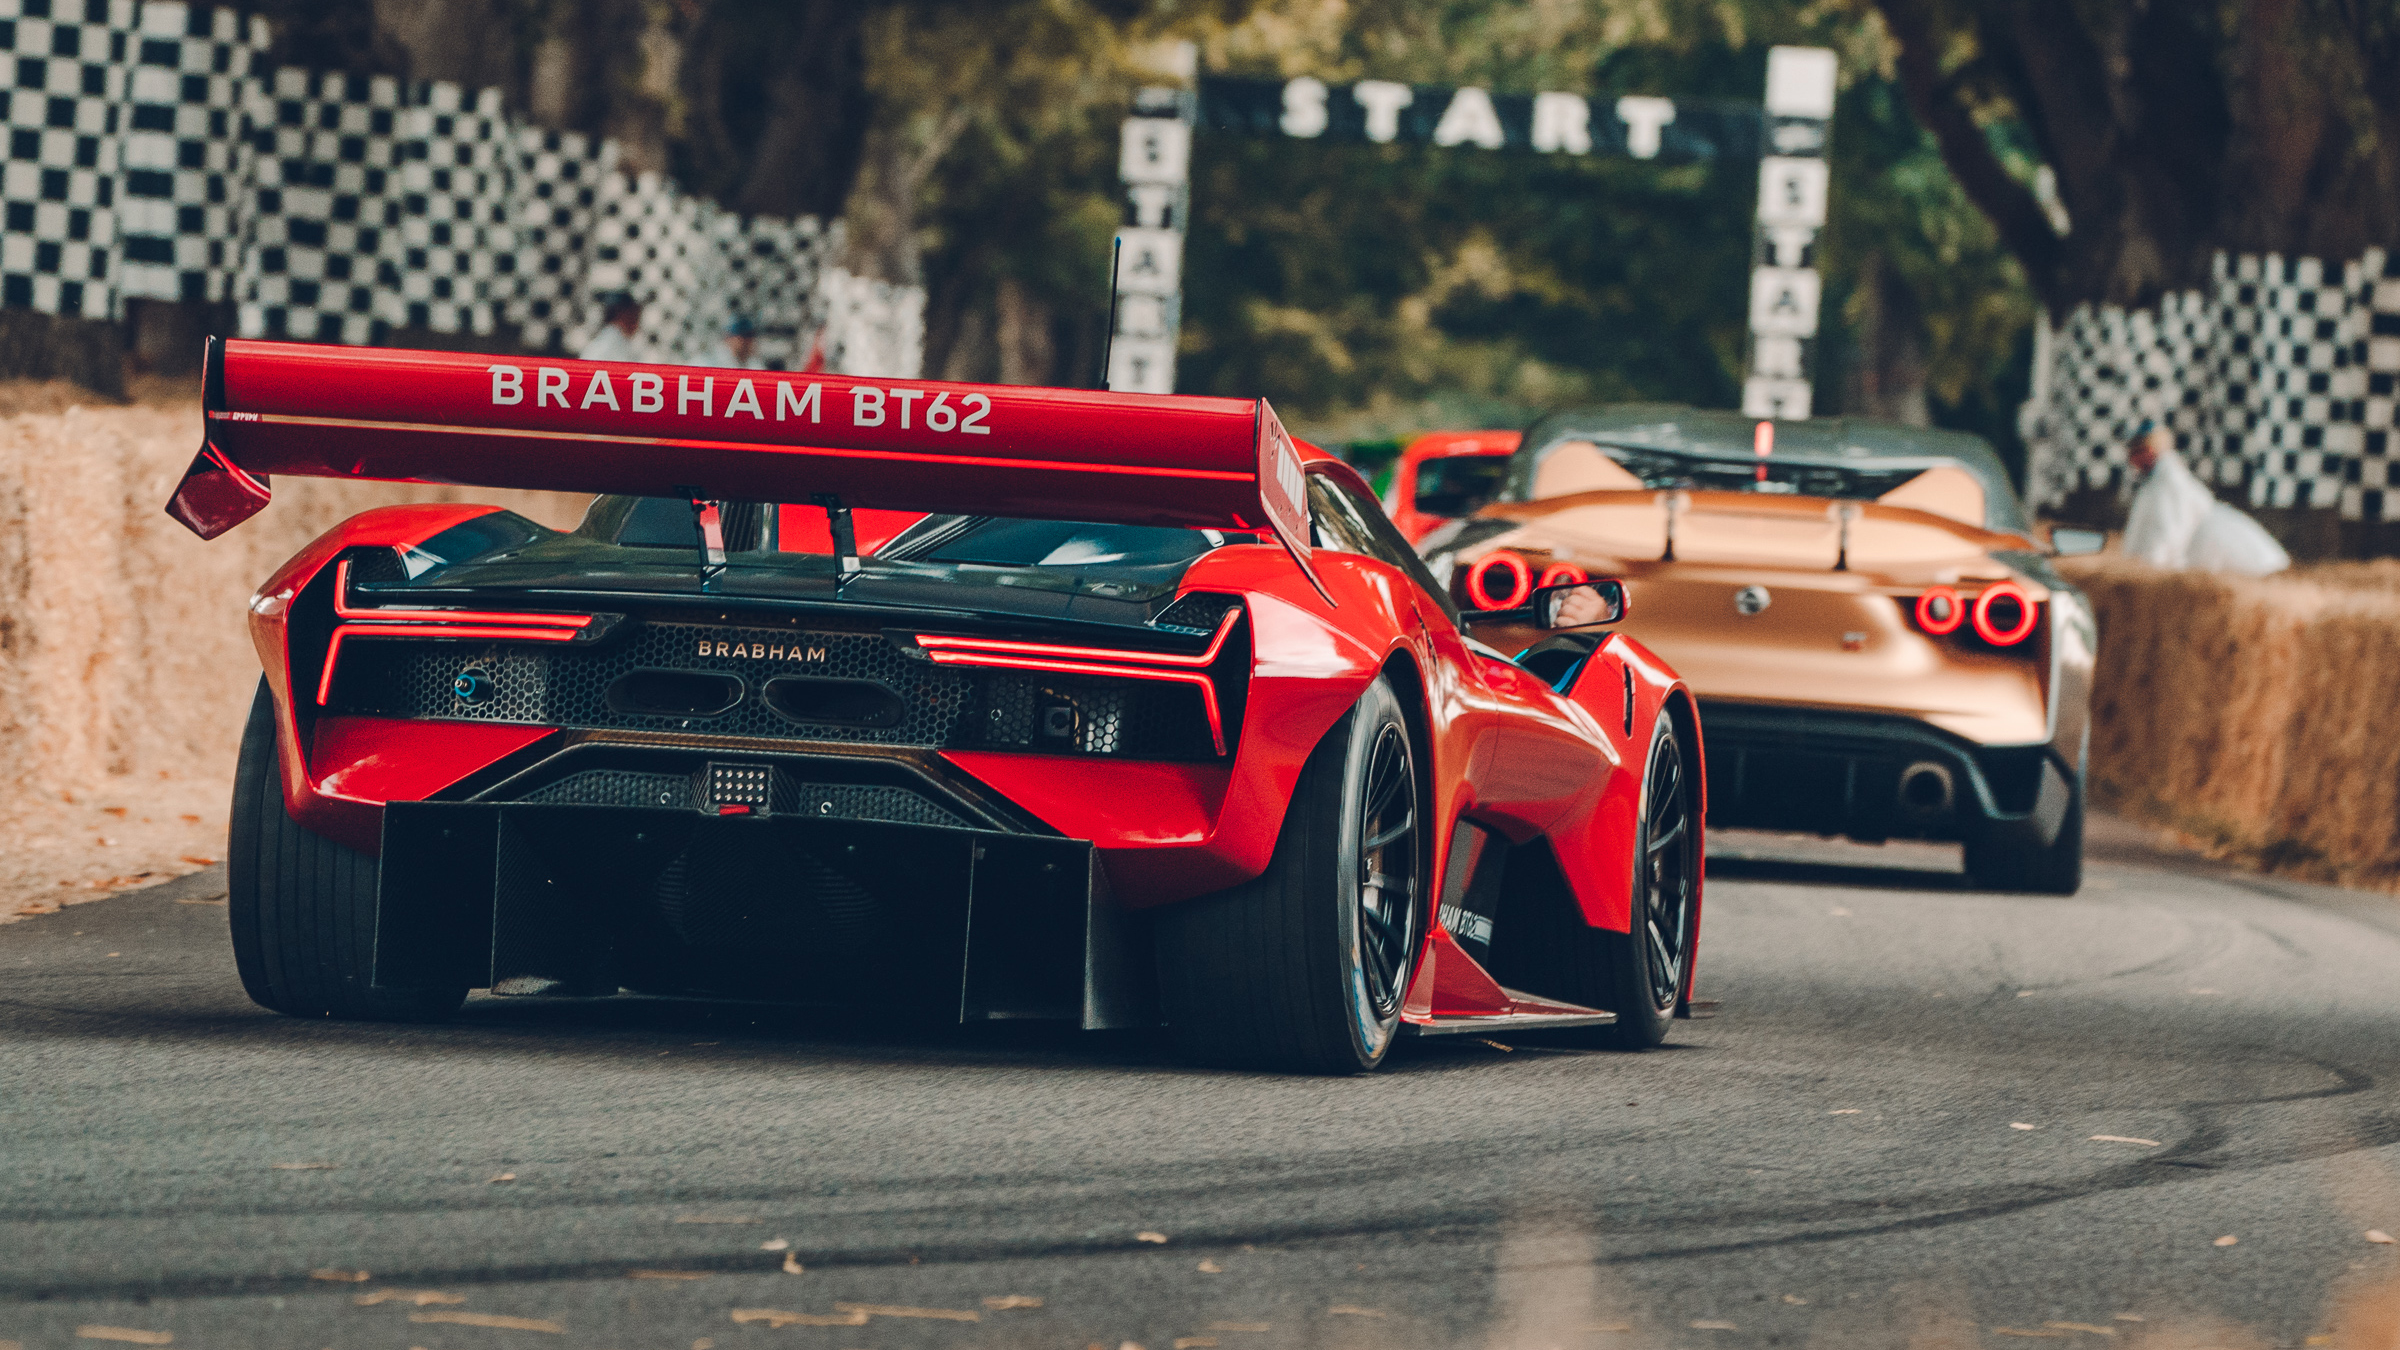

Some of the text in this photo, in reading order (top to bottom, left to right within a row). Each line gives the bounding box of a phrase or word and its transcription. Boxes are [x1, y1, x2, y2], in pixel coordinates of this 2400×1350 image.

[1279, 75, 1677, 160] START
[487, 364, 991, 434] BRABHAM BT62
[698, 641, 826, 663] BRABHAM
